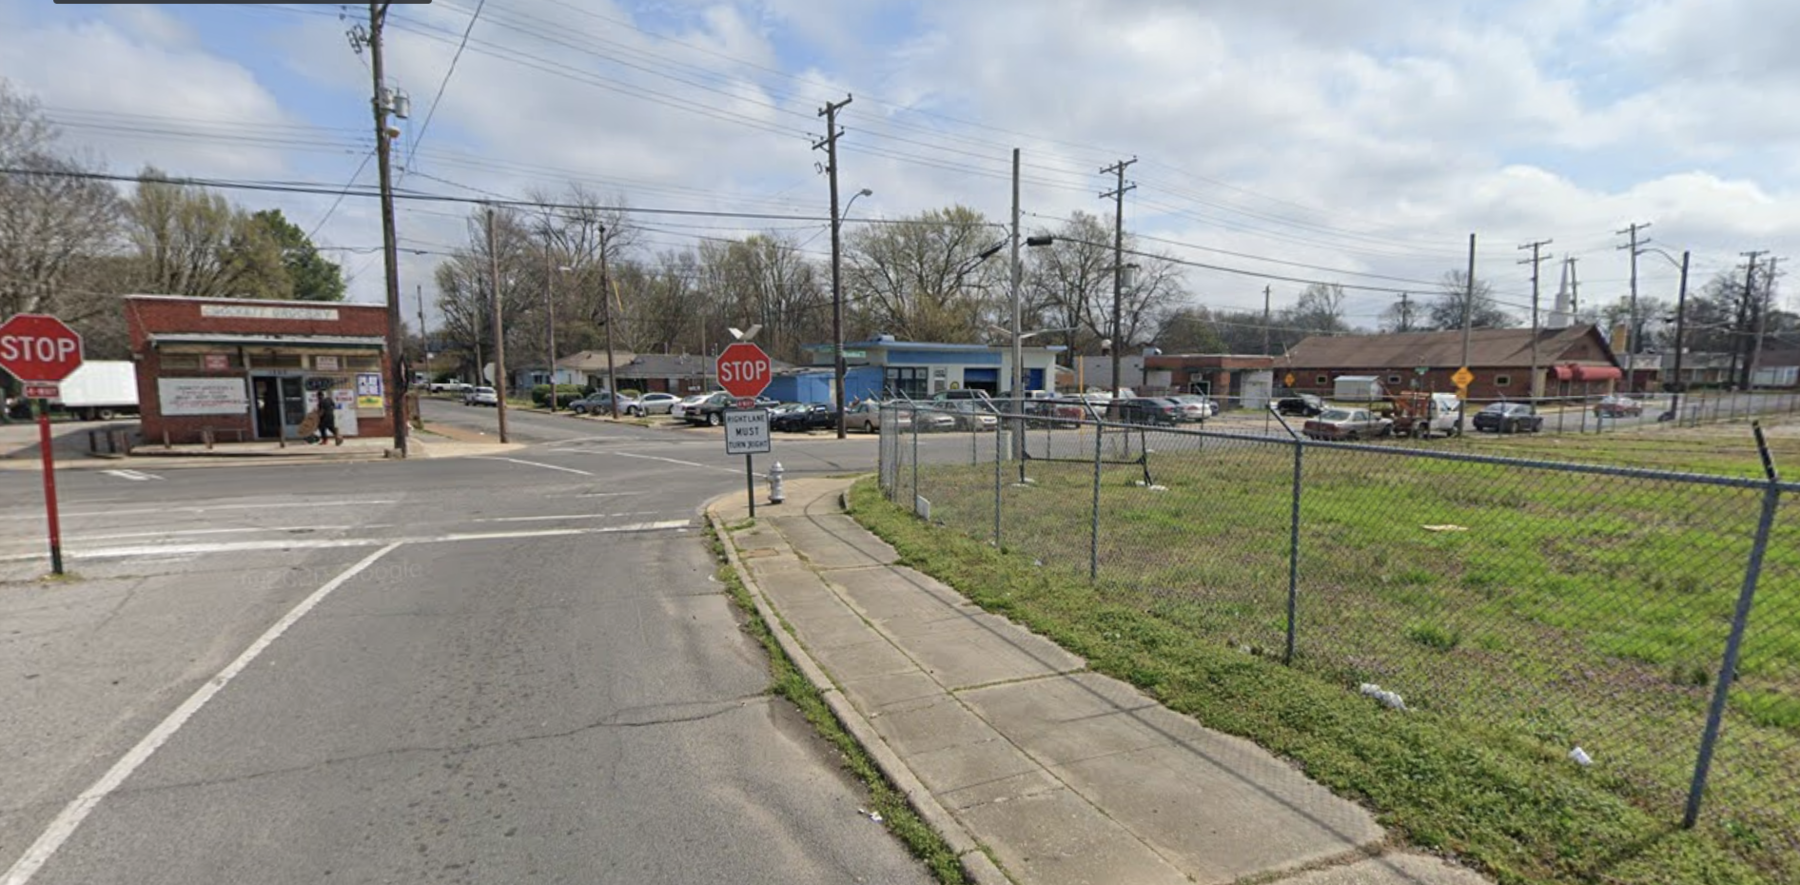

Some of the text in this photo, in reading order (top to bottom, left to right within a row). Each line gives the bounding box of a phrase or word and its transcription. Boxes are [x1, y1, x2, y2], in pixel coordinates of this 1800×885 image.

[1, 335, 76, 362] STOP
[721, 360, 767, 382] STOP
[727, 414, 765, 423] RIGHT LANE
[735, 426, 759, 437] MUST
[728, 440, 768, 449] TURN RIGHT
